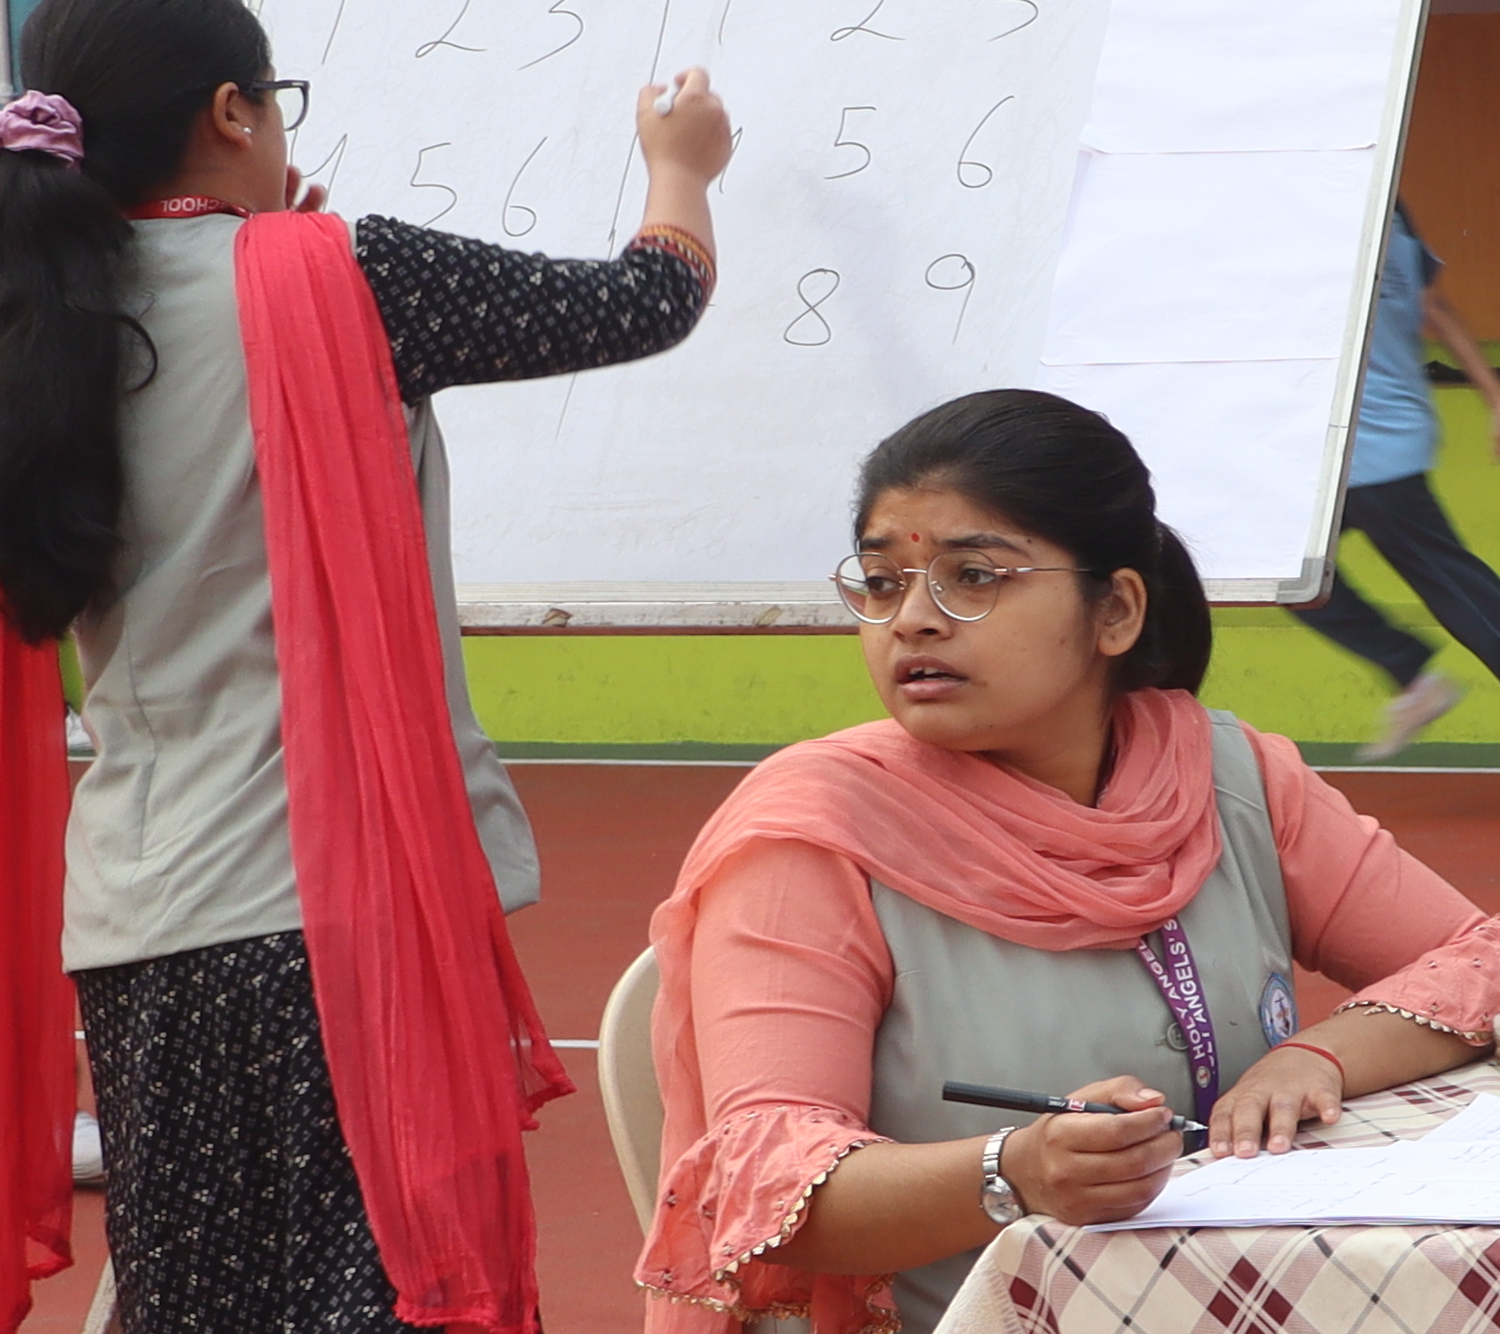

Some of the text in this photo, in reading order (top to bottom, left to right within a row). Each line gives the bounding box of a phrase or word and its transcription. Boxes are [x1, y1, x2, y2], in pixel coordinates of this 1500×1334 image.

[410, 141, 458, 229] 5
[502, 136, 549, 237] 6
[824, 105, 878, 180] 5
[957, 94, 1016, 189] 6
[783, 253, 976, 347] 8 9
[1176, 1005, 1206, 1060] HOLY
